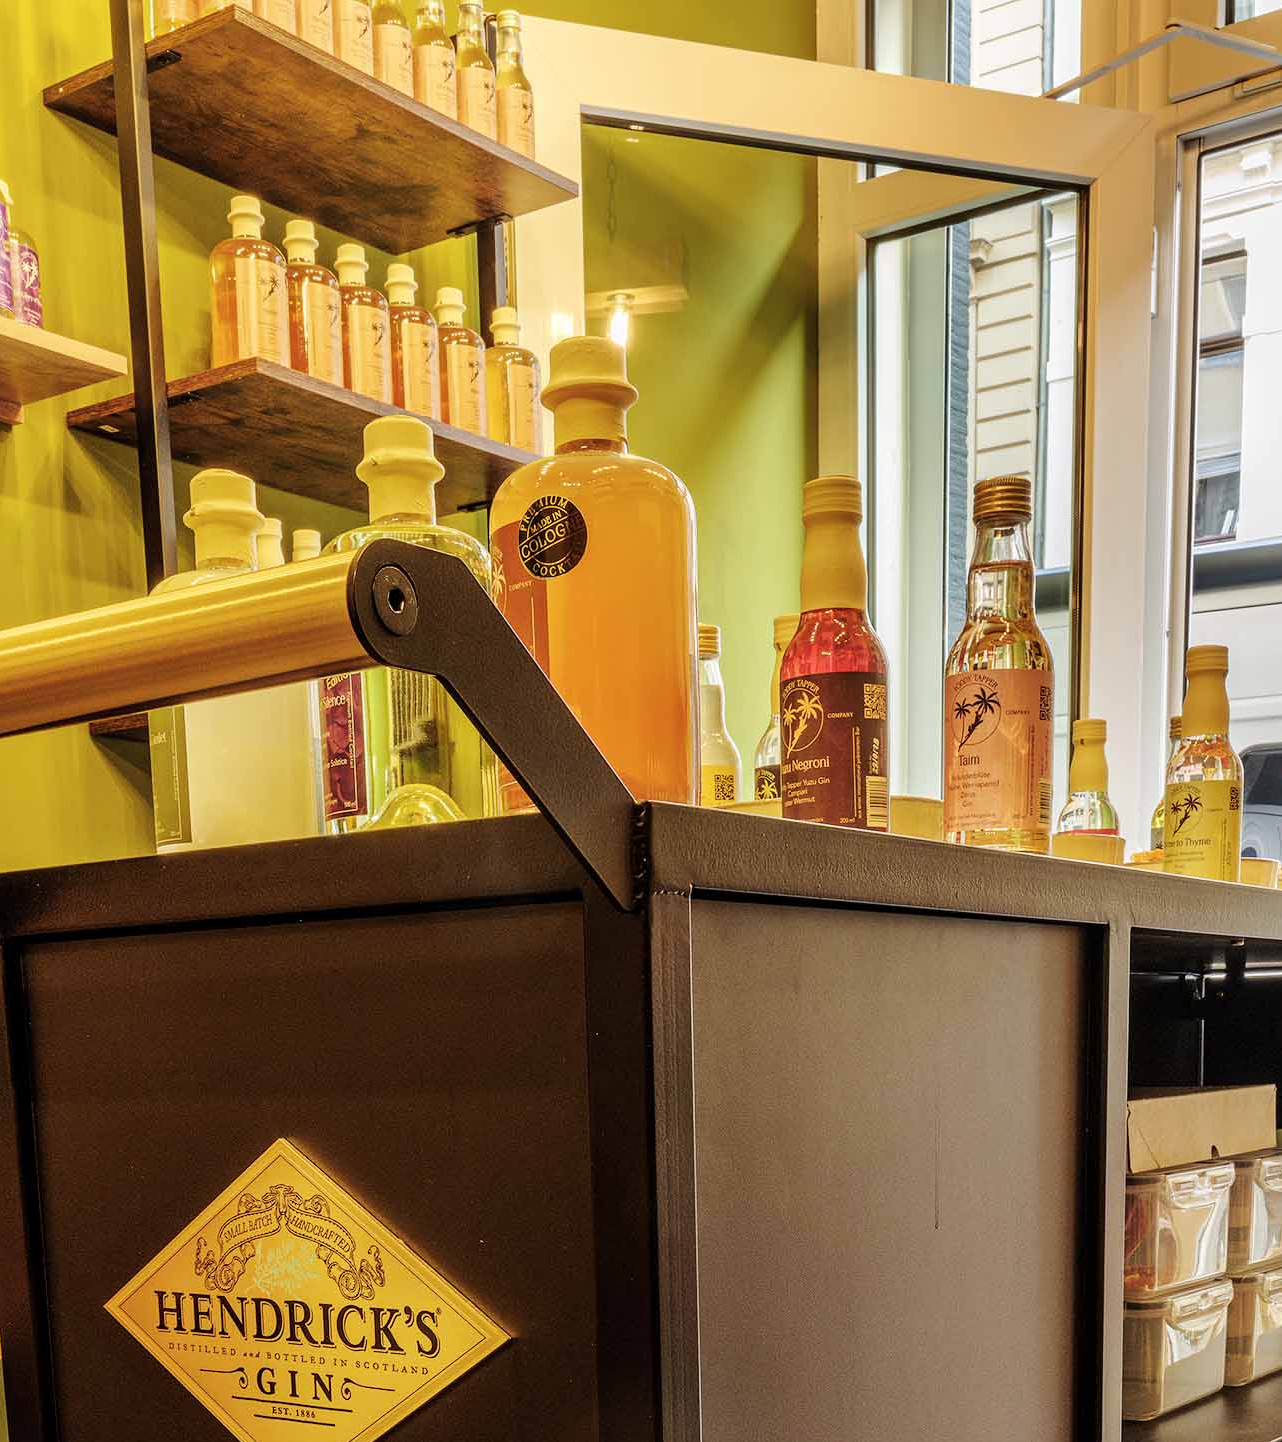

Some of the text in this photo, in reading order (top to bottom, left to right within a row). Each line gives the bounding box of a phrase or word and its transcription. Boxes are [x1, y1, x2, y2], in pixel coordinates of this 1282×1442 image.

[531, 510, 562, 533] MADE IN
[797, 679, 820, 694] TAPPER
[974, 674, 999, 688] TAPPER
[827, 711, 854, 719] COMPANY
[792, 756, 830, 772] Negroni
[959, 755, 980, 766] Taim
[817, 776, 830, 784] Gin
[224, 1214, 351, 1253] SMALL BATCH HANDCRAFTED
[154, 1290, 441, 1359] HENDRICK'S
[168, 1342, 237, 1357] DISTILLED
[266, 1351, 327, 1365] BOTTLED
[333, 1358, 349, 1368] IN
[355, 1361, 430, 1375] SCOTLAND
[256, 1367, 334, 1402] GIN
[272, 1406, 317, 1419] EST. 1886
